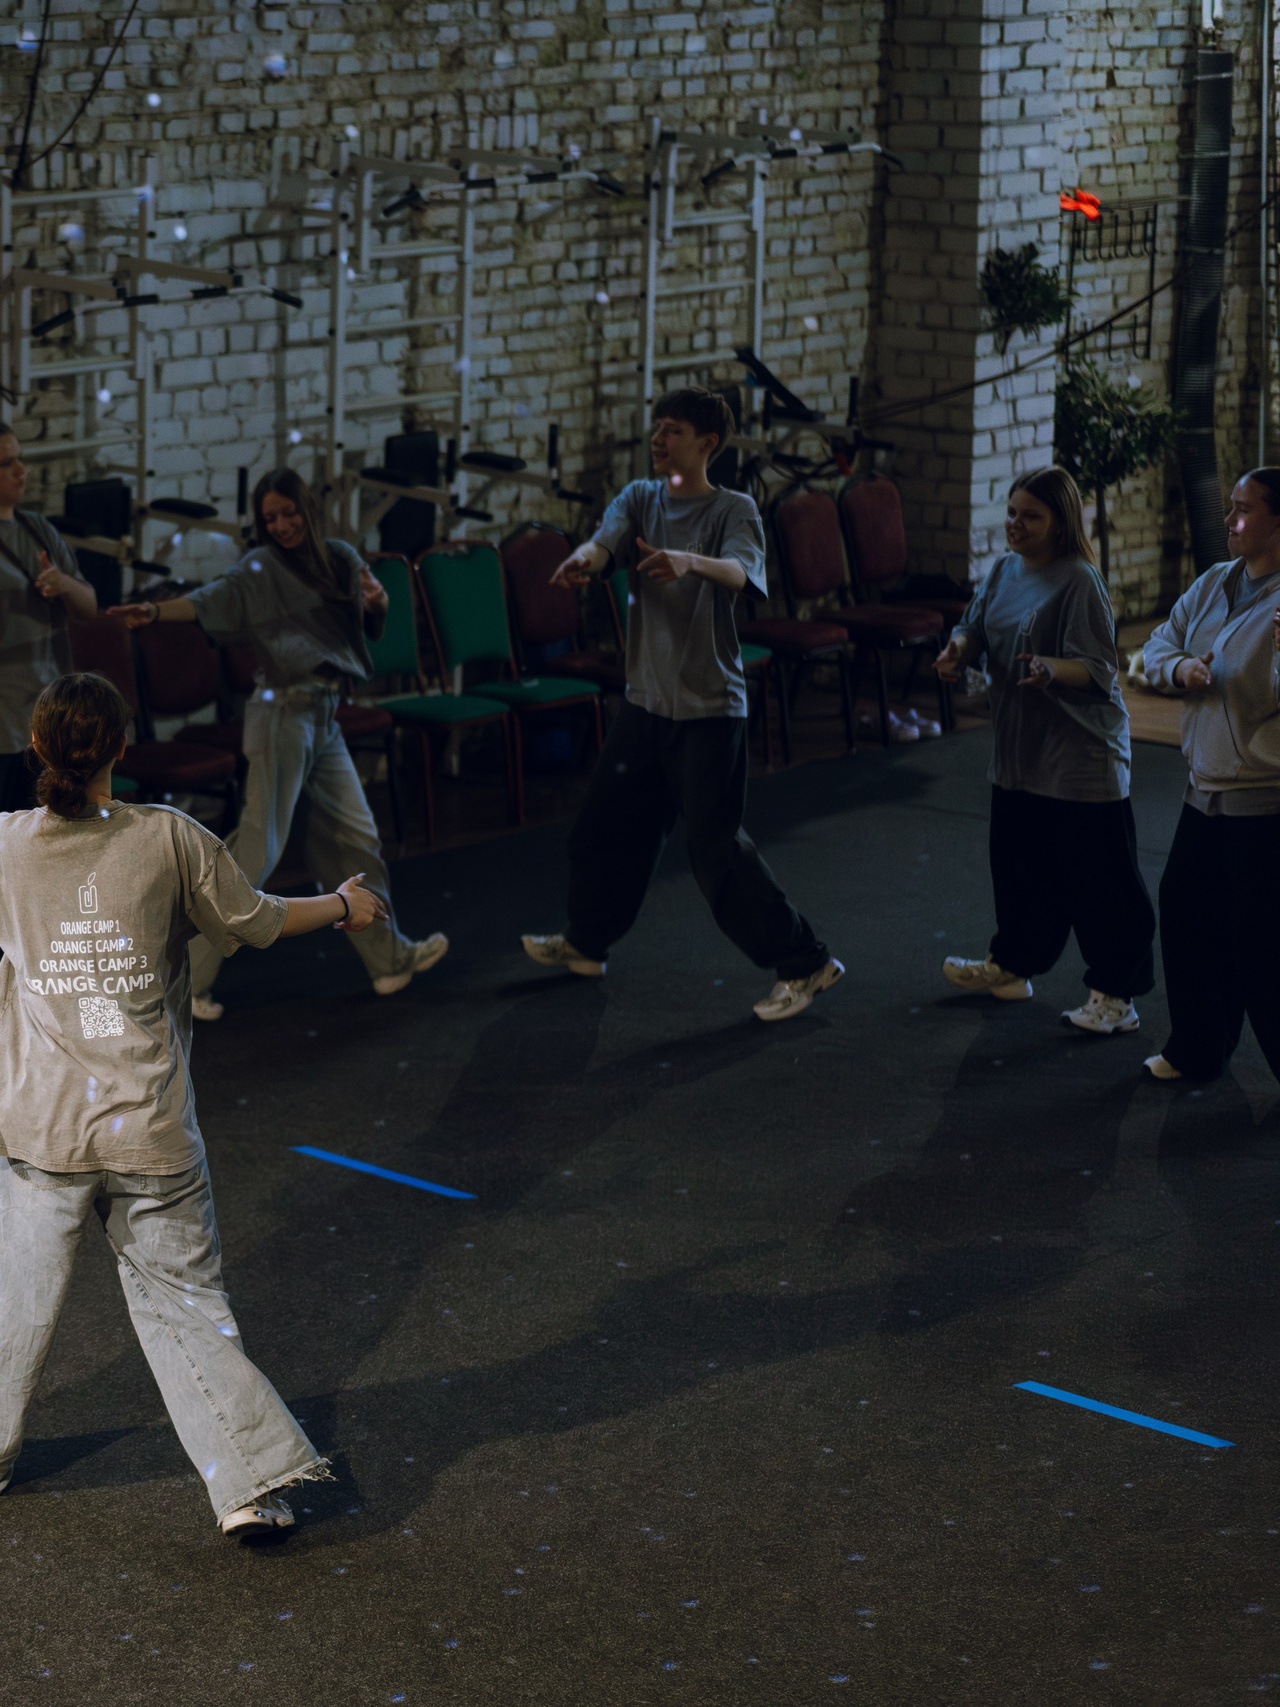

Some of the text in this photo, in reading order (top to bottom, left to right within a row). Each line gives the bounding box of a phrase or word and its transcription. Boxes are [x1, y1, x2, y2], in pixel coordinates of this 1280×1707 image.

[61, 920, 120, 934] ORANGE CAMP 1
[50, 938, 133, 954] ORANGE CAMP 2
[39, 955, 148, 973] ORANGE CAMP 3
[102, 973, 155, 994] CAMP
